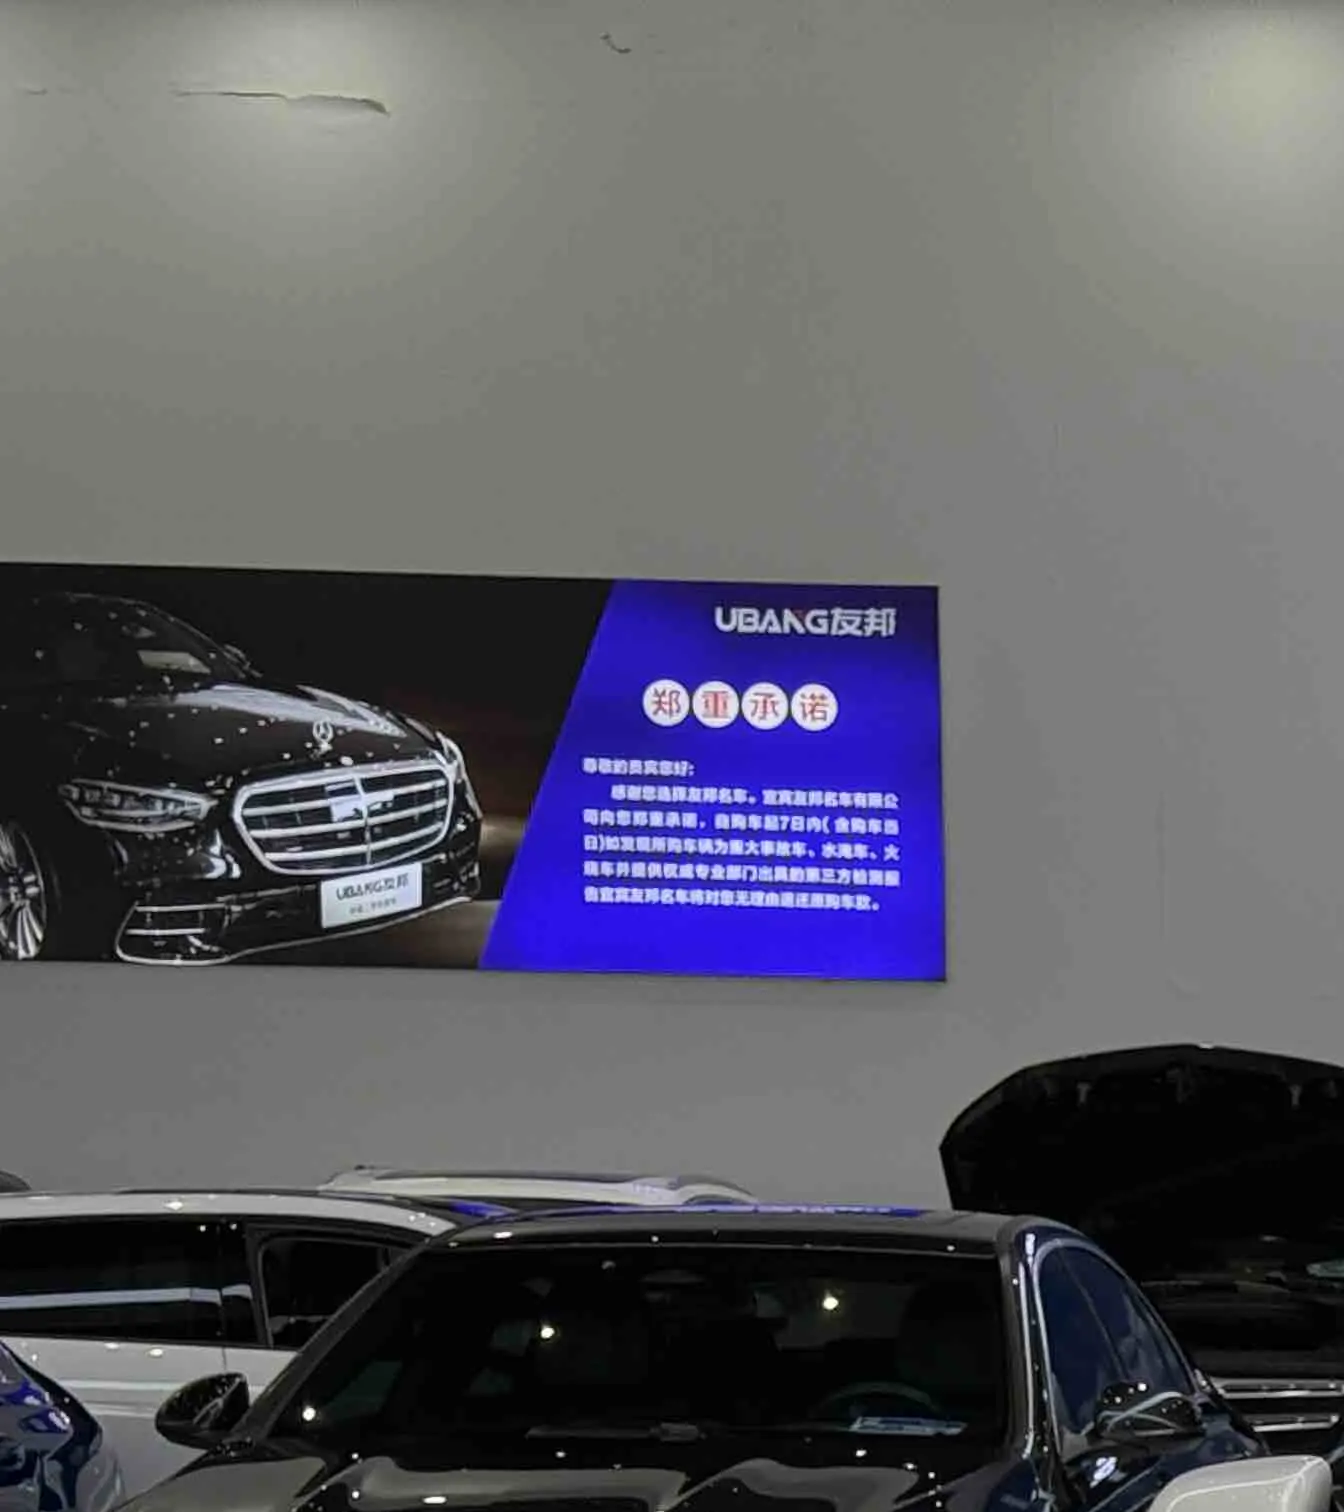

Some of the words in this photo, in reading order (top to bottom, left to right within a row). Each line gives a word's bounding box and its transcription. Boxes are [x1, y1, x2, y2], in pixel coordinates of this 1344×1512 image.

[715, 606, 897, 637] UBANG友邦
[651, 687, 830, 722] 郑重承诺
